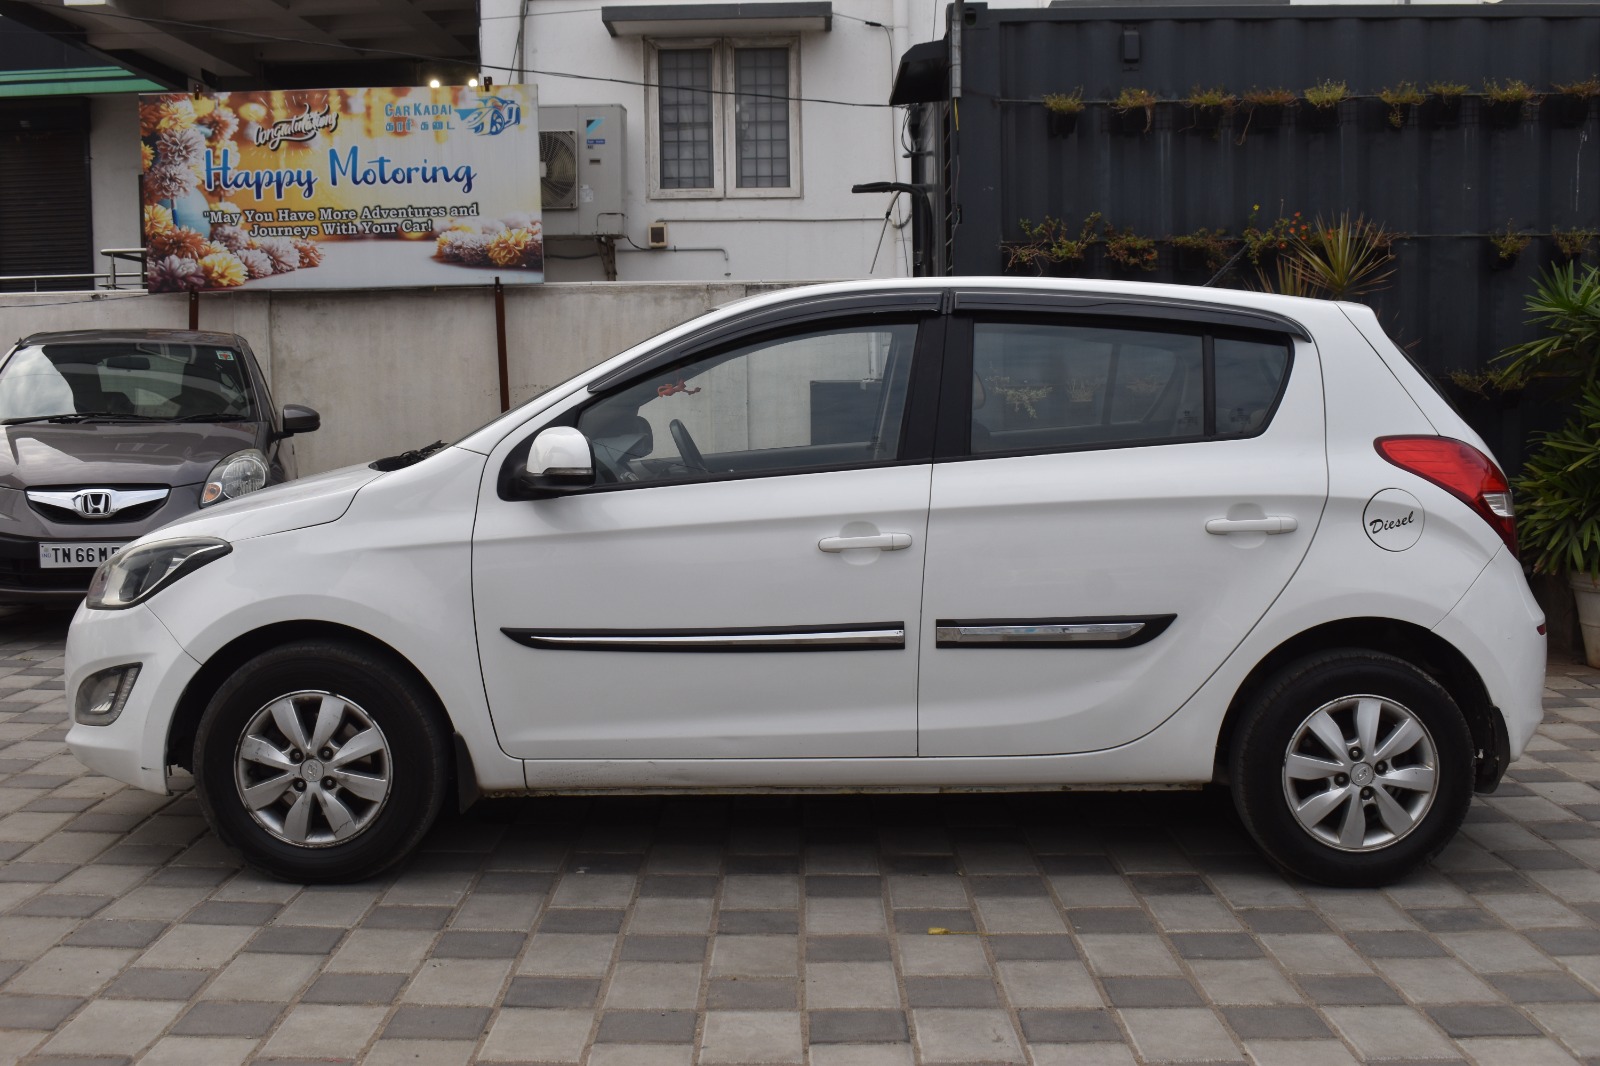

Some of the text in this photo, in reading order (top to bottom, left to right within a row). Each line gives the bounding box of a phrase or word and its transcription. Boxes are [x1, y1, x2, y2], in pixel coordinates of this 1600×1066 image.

[254, 102, 339, 151] Congratulations
[204, 145, 477, 200] Happy Motoring
[244, 209, 273, 222] You
[277, 208, 315, 222] Have
[319, 207, 357, 221] More
[361, 205, 446, 219] Adventures
[450, 202, 479, 217] and
[249, 219, 433, 239] Journeys With Your Car!
[1369, 510, 1414, 534] Diesel
[52, 547, 71, 563] TN
[76, 547, 95, 563] 66
